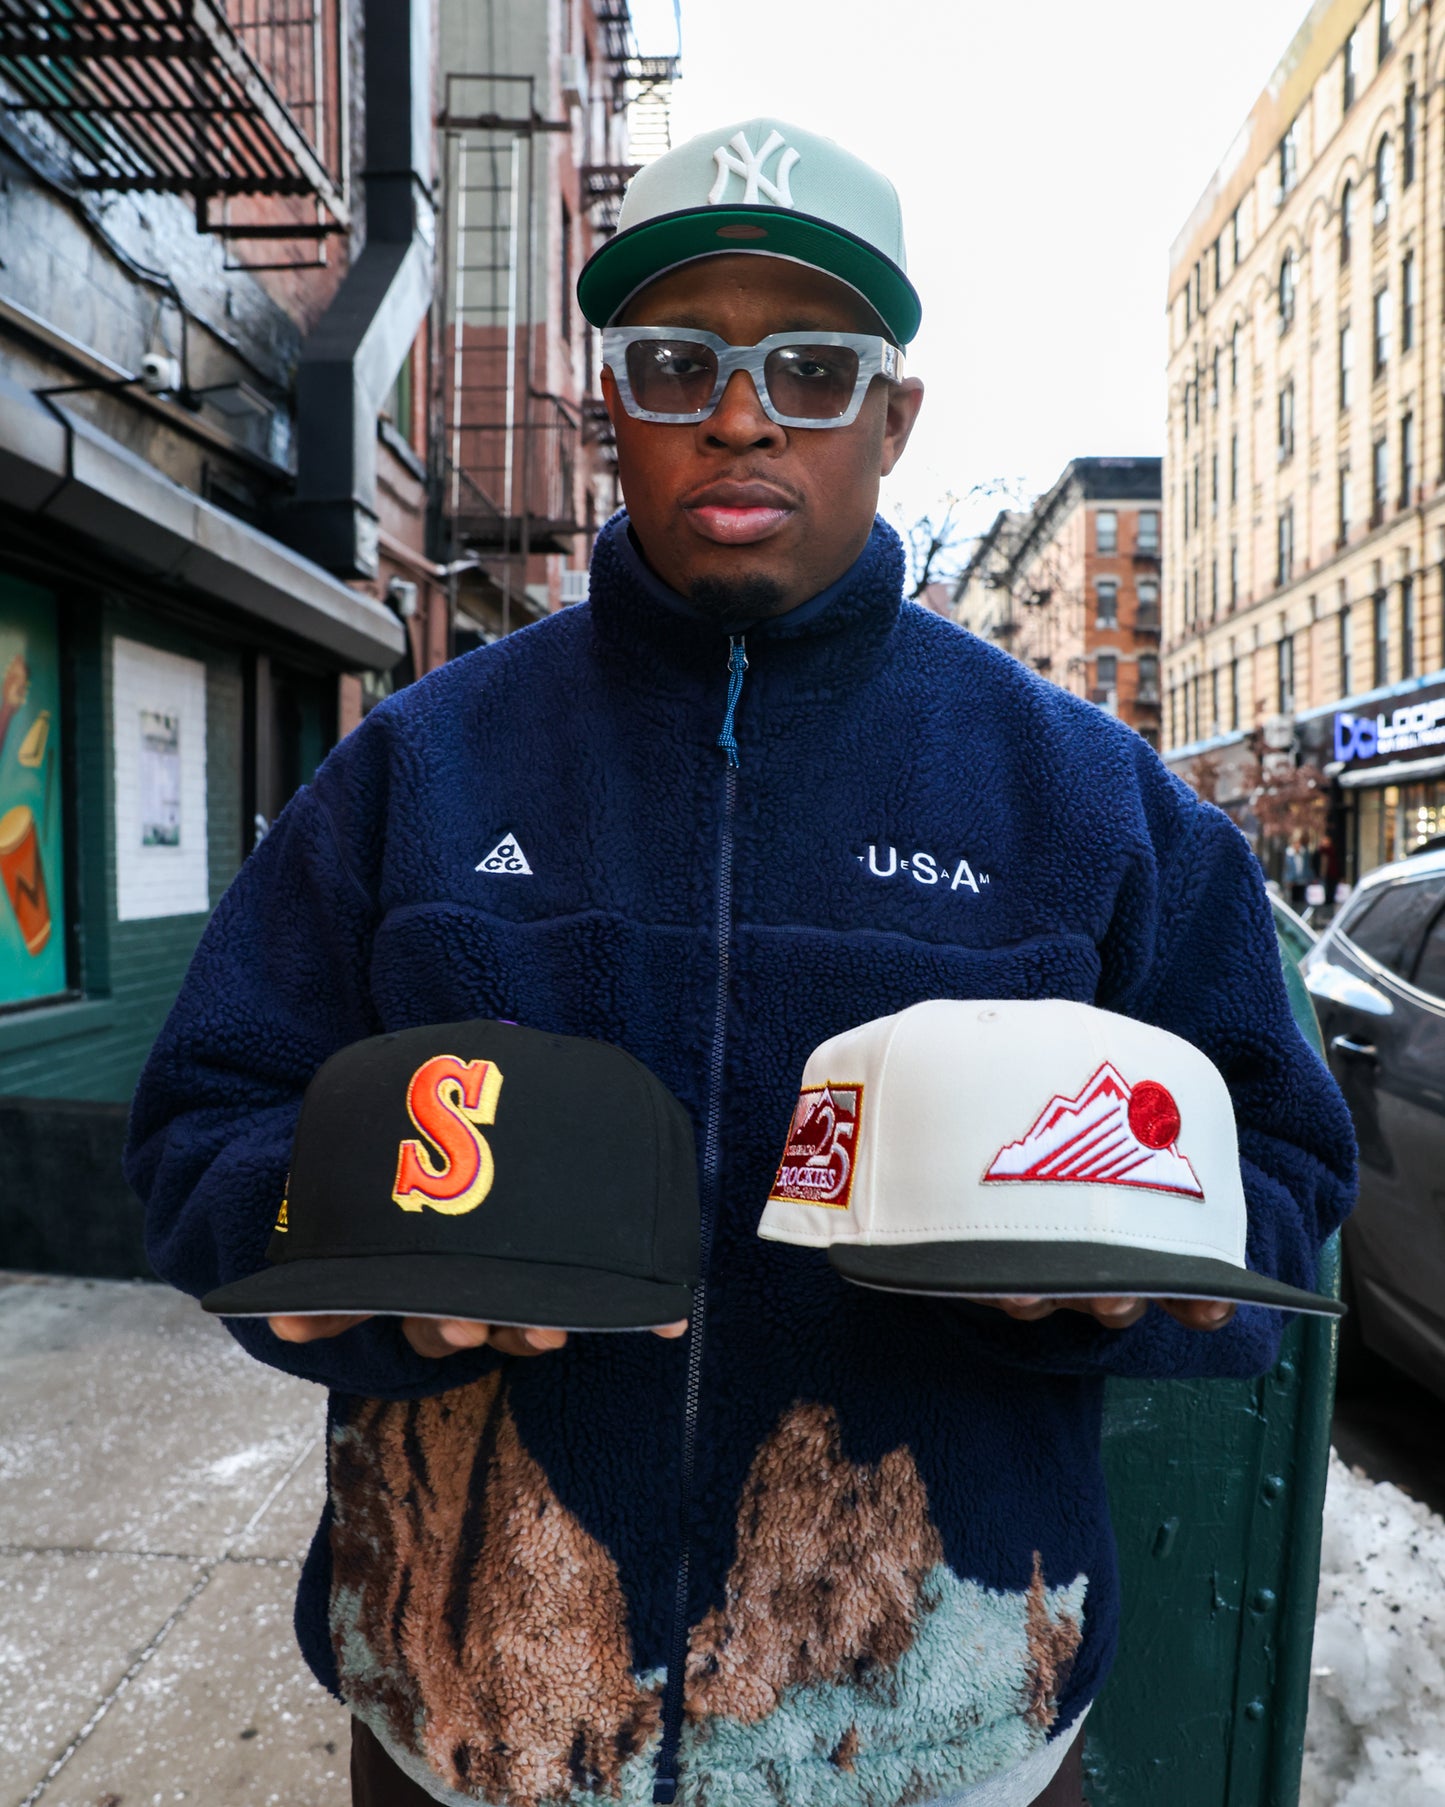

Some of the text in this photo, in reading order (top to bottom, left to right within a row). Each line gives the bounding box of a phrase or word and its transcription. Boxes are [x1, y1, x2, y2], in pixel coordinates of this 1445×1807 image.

[708, 129, 801, 209] NY
[392, 1054, 504, 1216] S
[776, 1166, 836, 1190] ROCKIES
